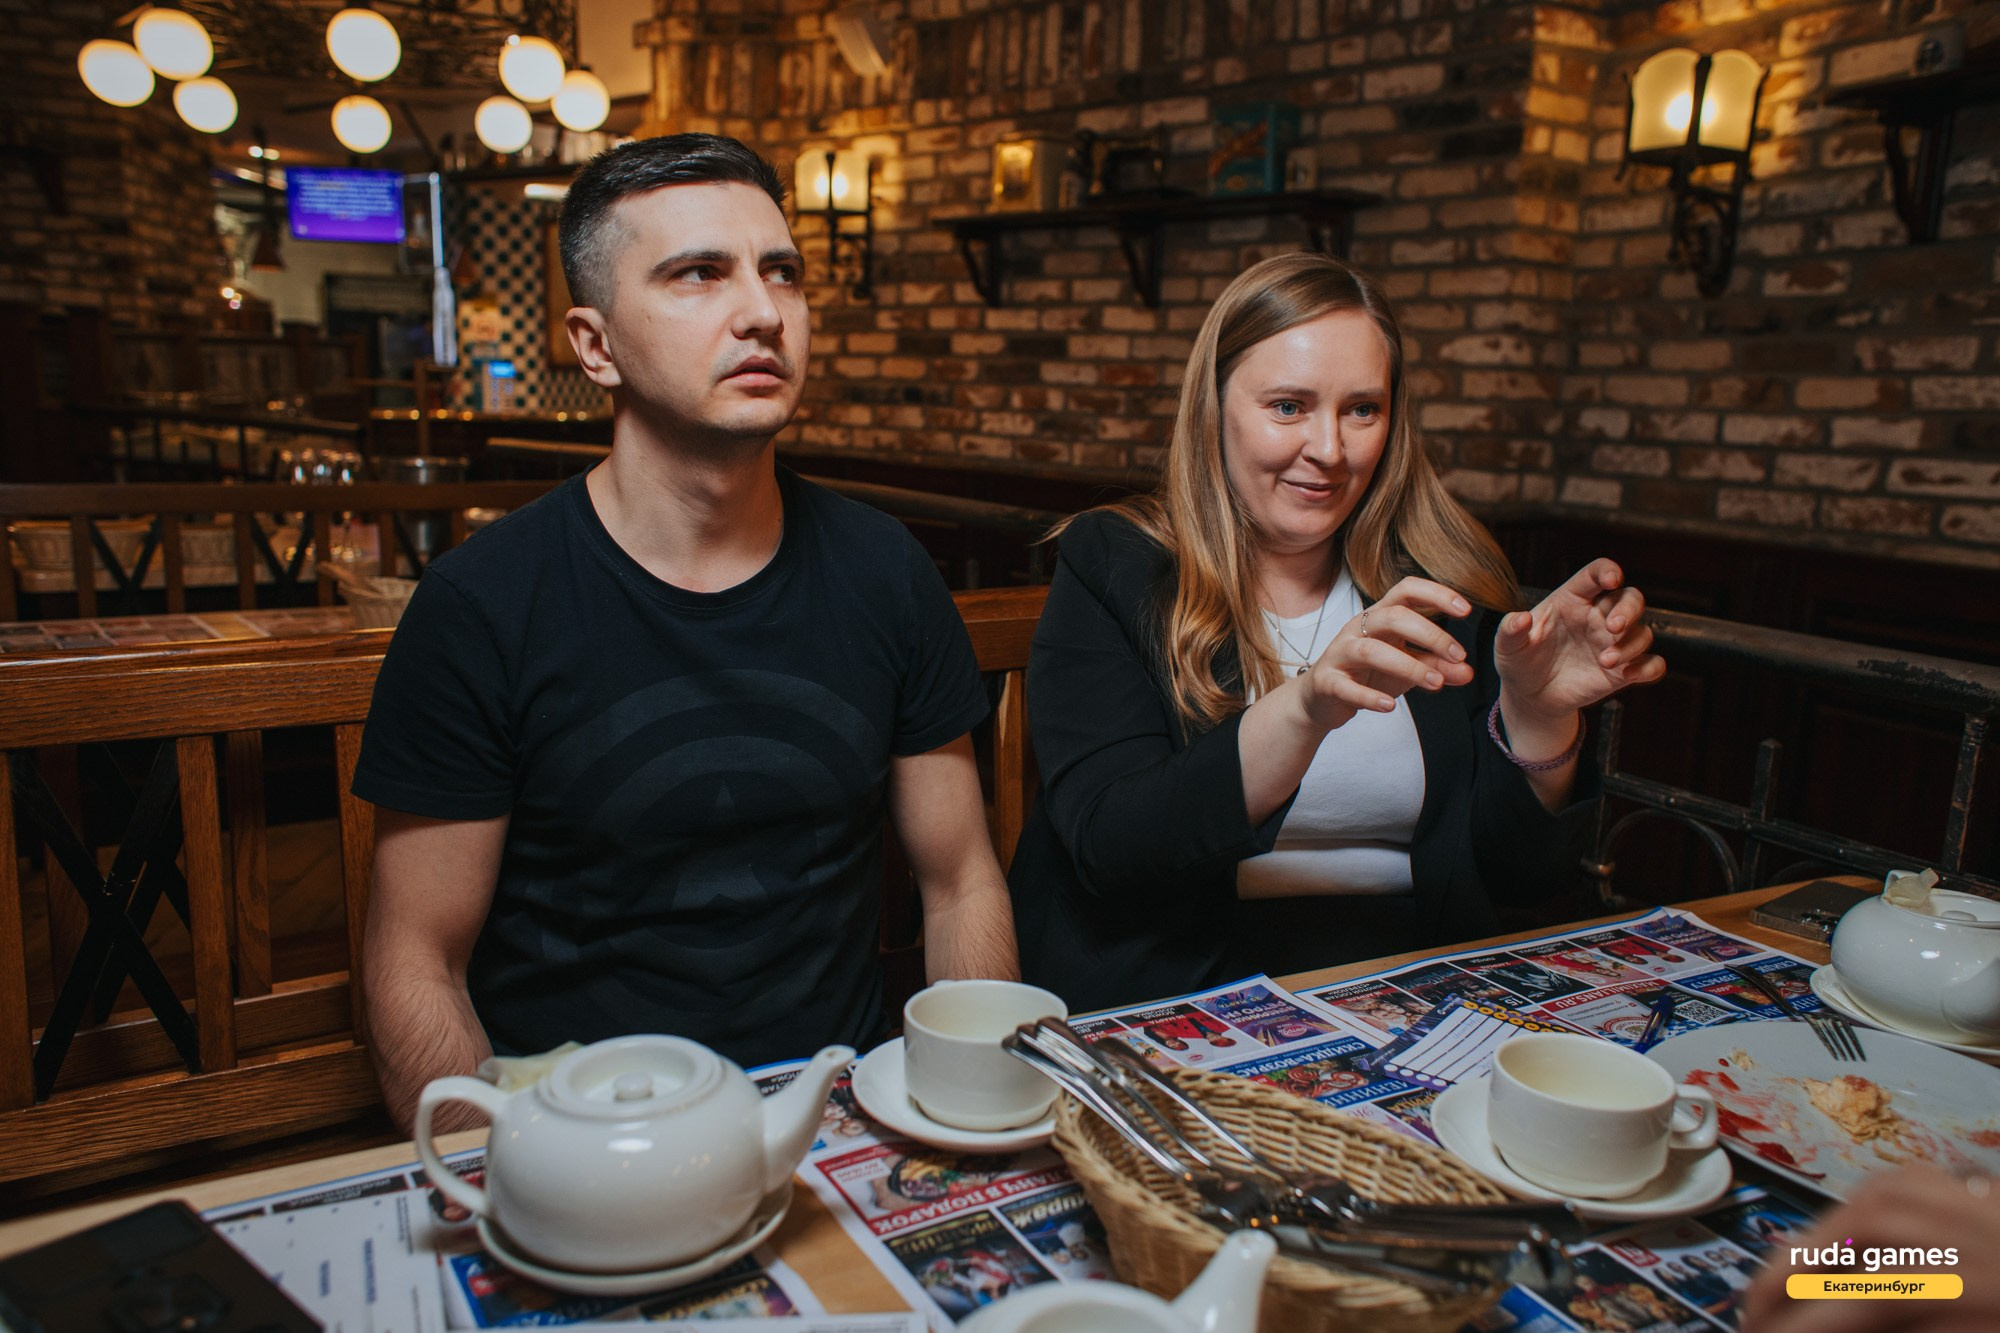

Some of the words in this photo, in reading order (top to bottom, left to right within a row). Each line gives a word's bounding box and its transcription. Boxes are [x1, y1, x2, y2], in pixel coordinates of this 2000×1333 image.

[1241, 1001, 1288, 1015] РЕТРО
[1504, 996, 1524, 1007] 15
[1555, 980, 1660, 1009] MAXIMILIANS.RU
[1232, 1041, 1367, 1078] СКИДКА=ВОЗРАС
[873, 1190, 986, 1235] ПОДАРОК
